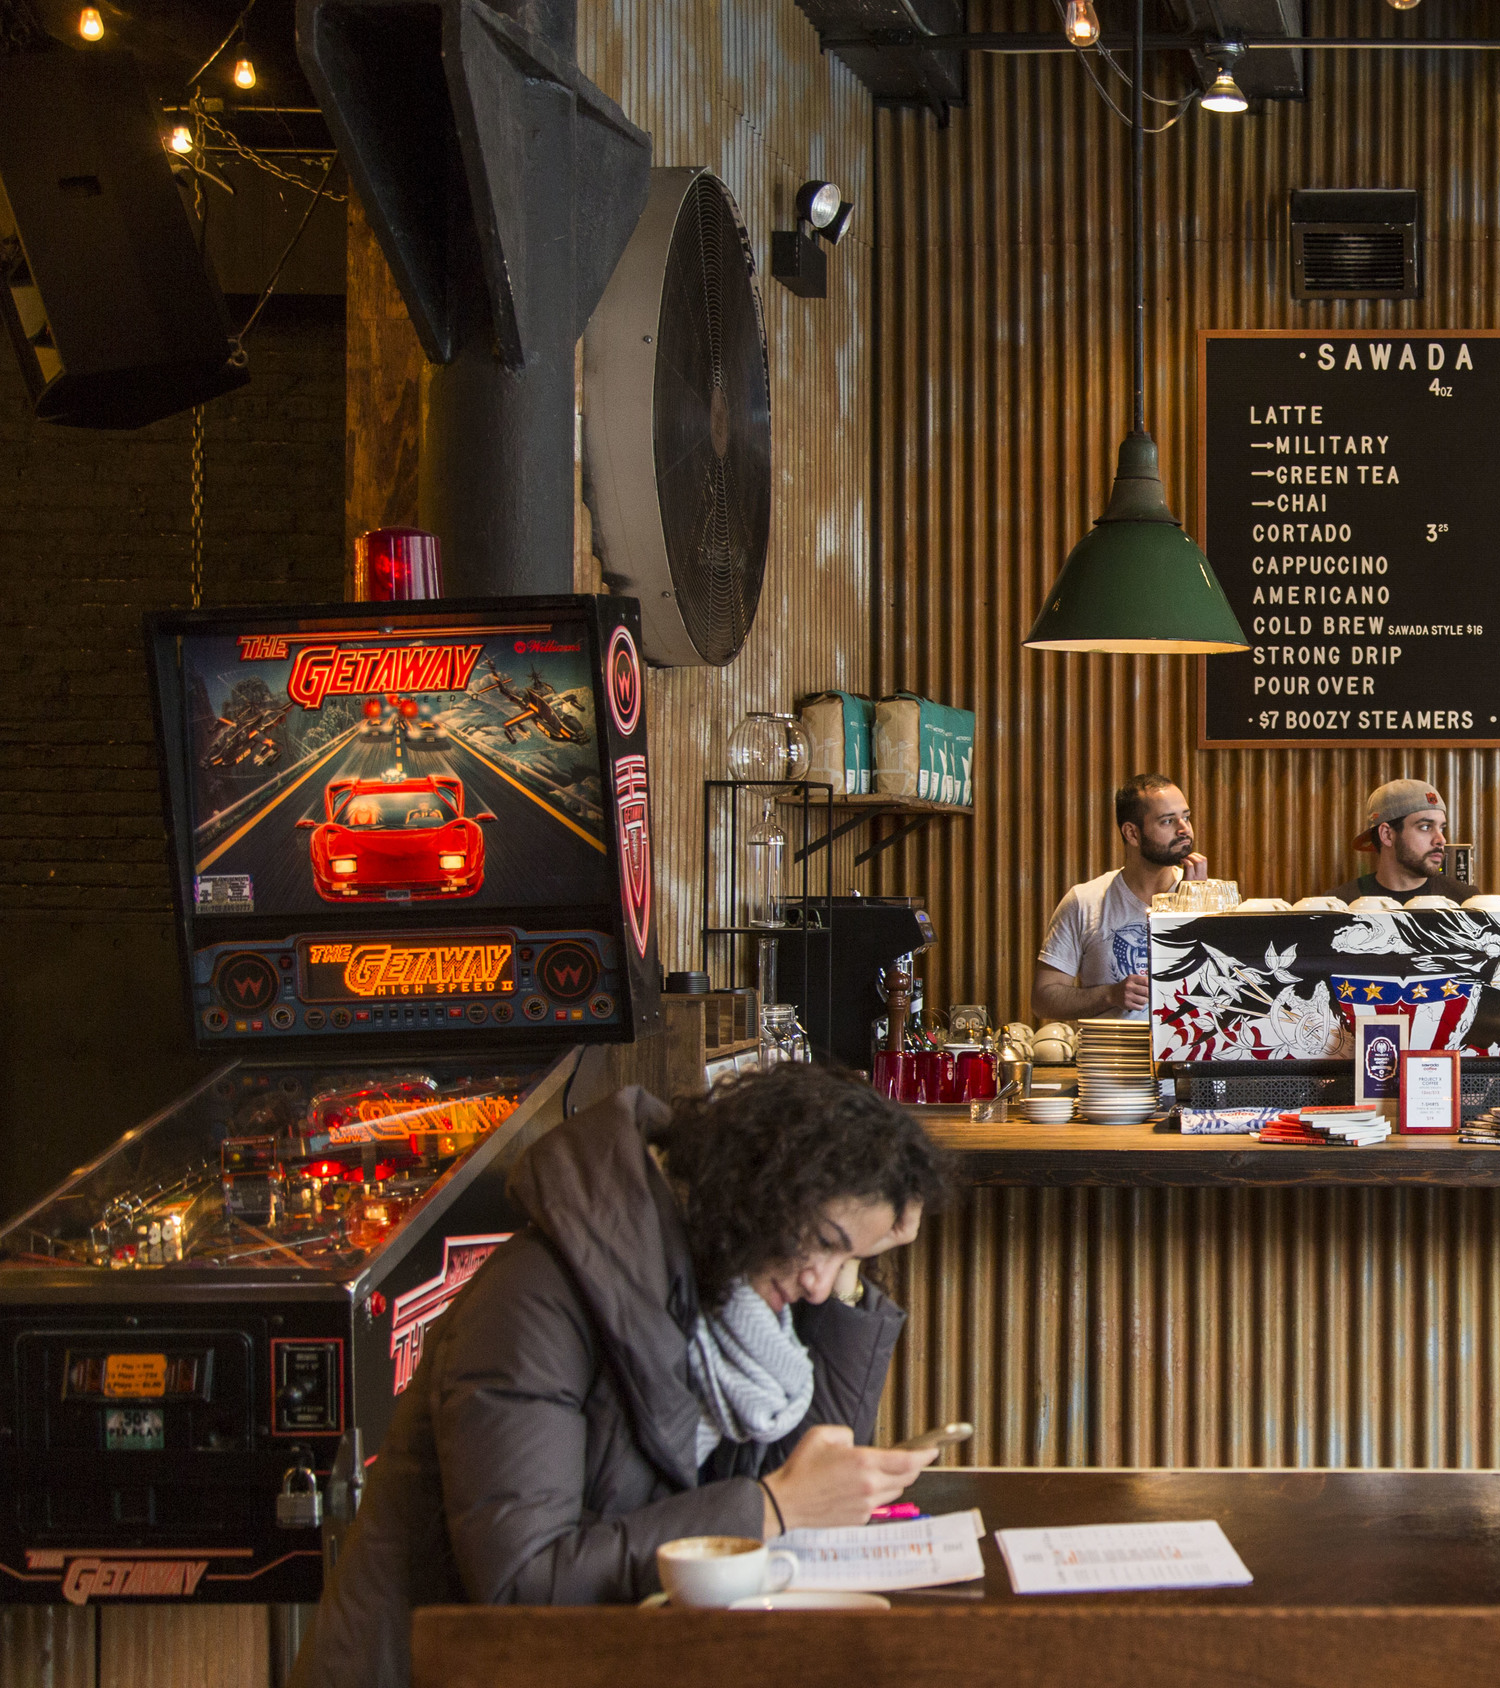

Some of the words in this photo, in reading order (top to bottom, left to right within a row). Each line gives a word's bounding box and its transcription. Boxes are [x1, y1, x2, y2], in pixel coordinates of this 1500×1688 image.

[1318, 343, 1474, 371] SAWADA
[1250, 406, 1323, 425] LATTE
[1276, 435, 1389, 455] MILITARY
[1276, 465, 1348, 485] GREEN
[1357, 465, 1400, 485] TEA
[1276, 493, 1327, 513] CHAI
[1252, 523, 1352, 543] CORTADO
[1252, 555, 1388, 575] CAPPUCCINO
[1252, 585, 1390, 605] AMERICANO
[1253, 616, 1312, 635] COLD
[1323, 616, 1384, 635] BREW
[1387, 624, 1430, 636] SAWADA
[1431, 624, 1464, 636] STYLE
[1466, 623, 1483, 636] $16
[528, 640, 581, 653] Williams
[1253, 646, 1341, 665] STRONG
[1351, 645, 1402, 665] DRIP
[239, 636, 290, 661] THE
[287, 645, 485, 709] GETAWAY
[1254, 676, 1310, 695] POUR
[1317, 676, 1375, 695] OVER
[1259, 710, 1280, 731] $7
[1285, 710, 1351, 730] BOOZY
[1358, 710, 1474, 730] STEAMERS
[309, 944, 352, 965] THE
[344, 944, 512, 996] GETAWAY
[378, 983, 424, 995] HIGH
[436, 982, 494, 994] SPEED
[501, 980, 514, 992] II
[62, 1557, 209, 1607] GETAWAY
